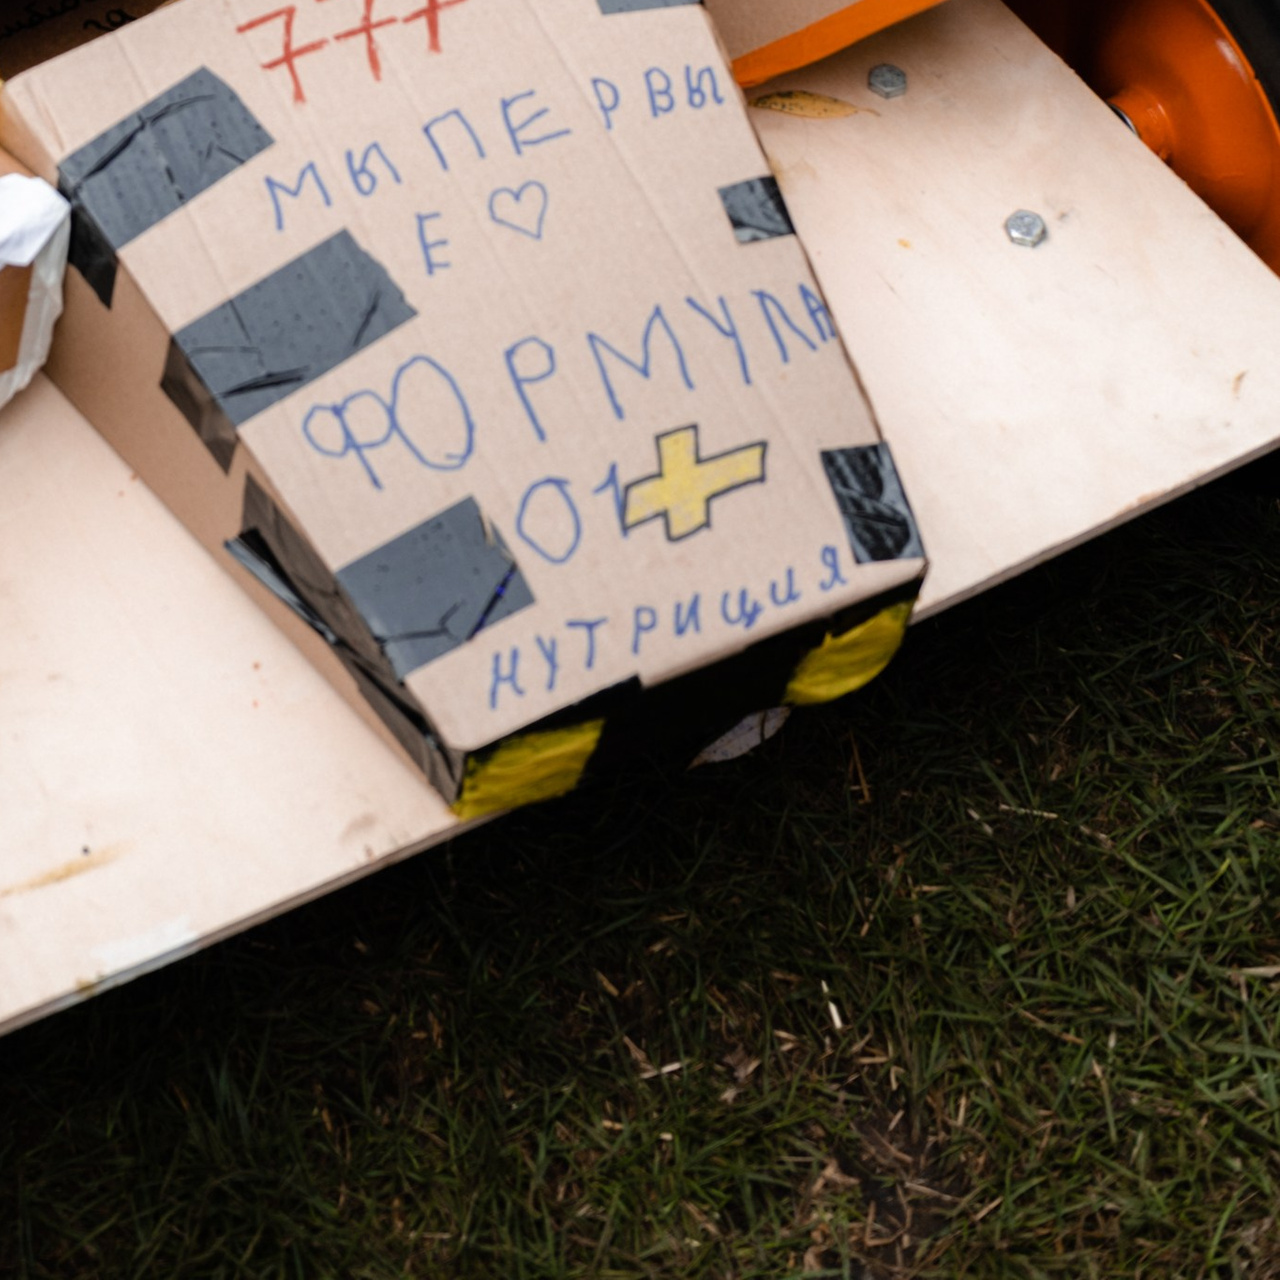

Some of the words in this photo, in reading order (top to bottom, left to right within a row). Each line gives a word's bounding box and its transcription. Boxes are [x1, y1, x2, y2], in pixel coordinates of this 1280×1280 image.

[264, 140, 402, 231] МЫ
[301, 283, 837, 490] ФОРМУЛА
[489, 543, 848, 710] НУТРИЦИЯ
